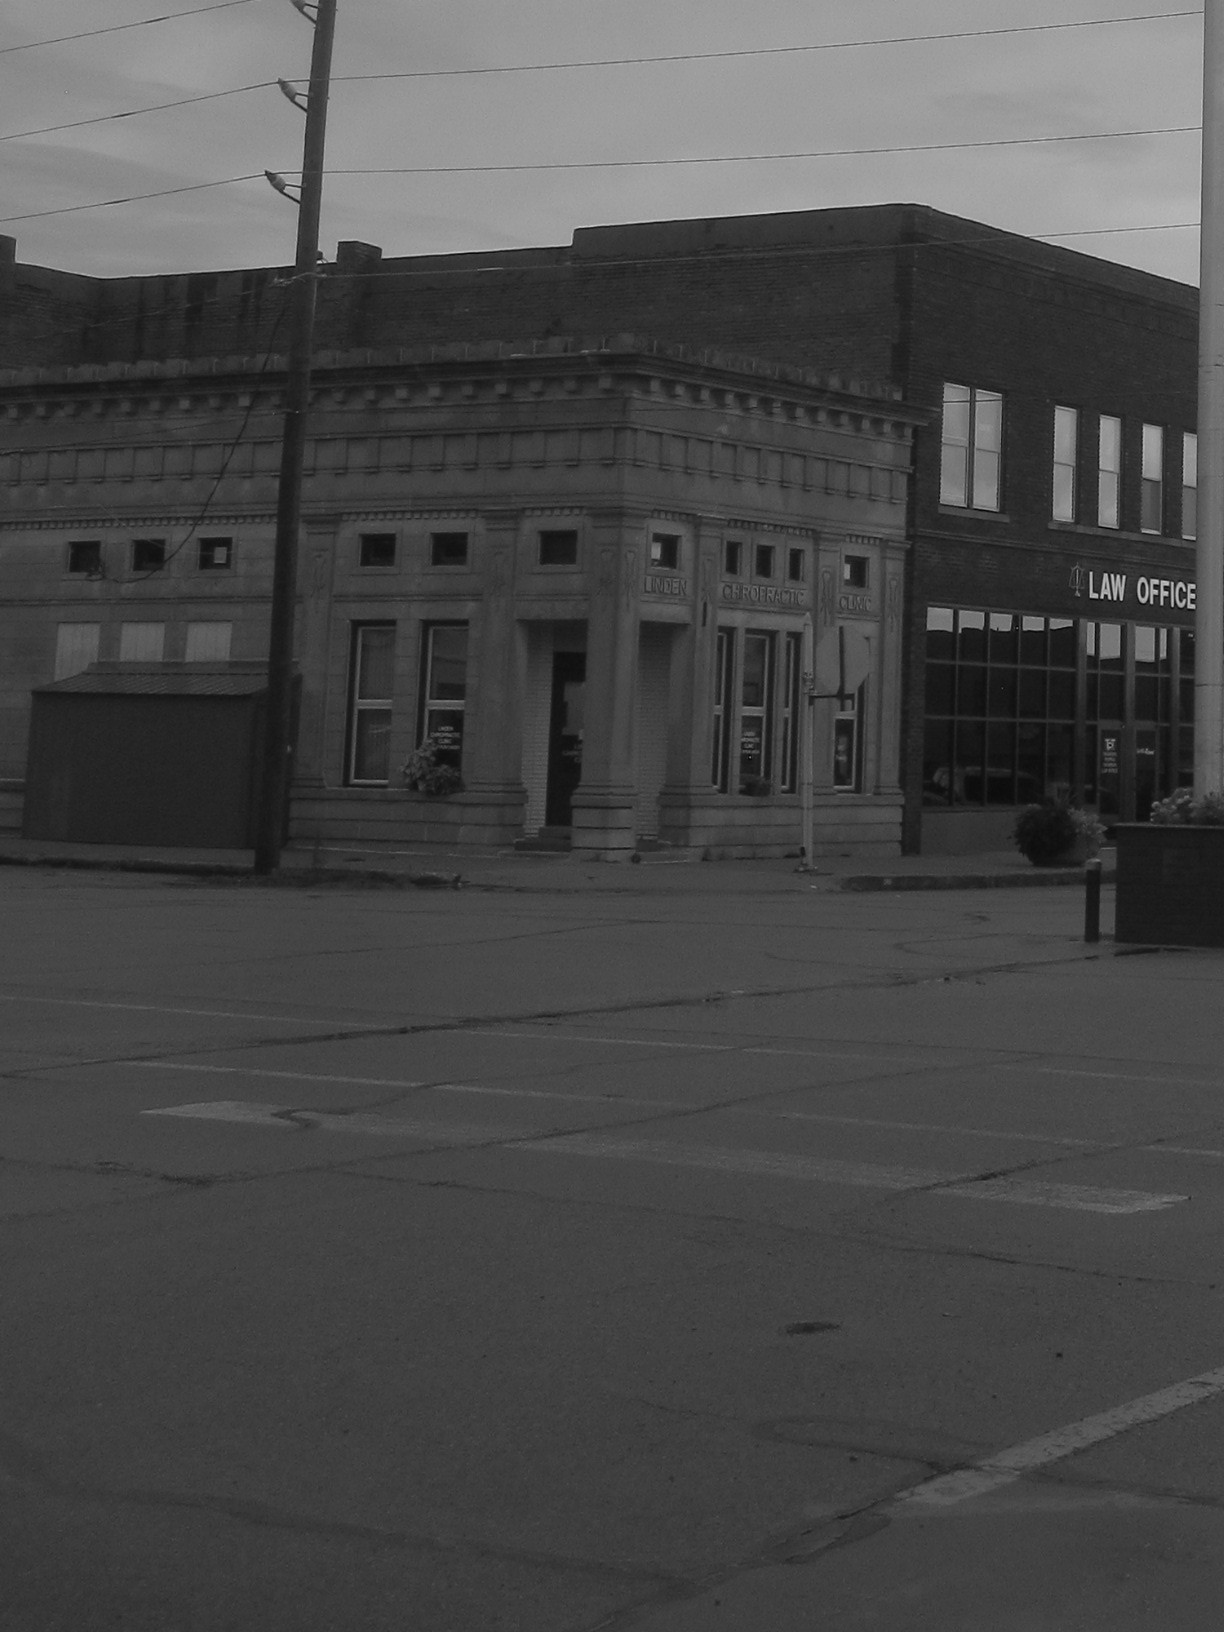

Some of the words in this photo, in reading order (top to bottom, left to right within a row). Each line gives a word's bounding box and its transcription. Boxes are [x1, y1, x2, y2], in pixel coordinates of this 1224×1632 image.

[643, 575, 687, 596] LINDEN
[722, 583, 805, 607] CHIROPRACTIC
[838, 595, 872, 612] CLINIC
[1089, 571, 1126, 601] LAW
[1137, 576, 1196, 610] OFFICE
